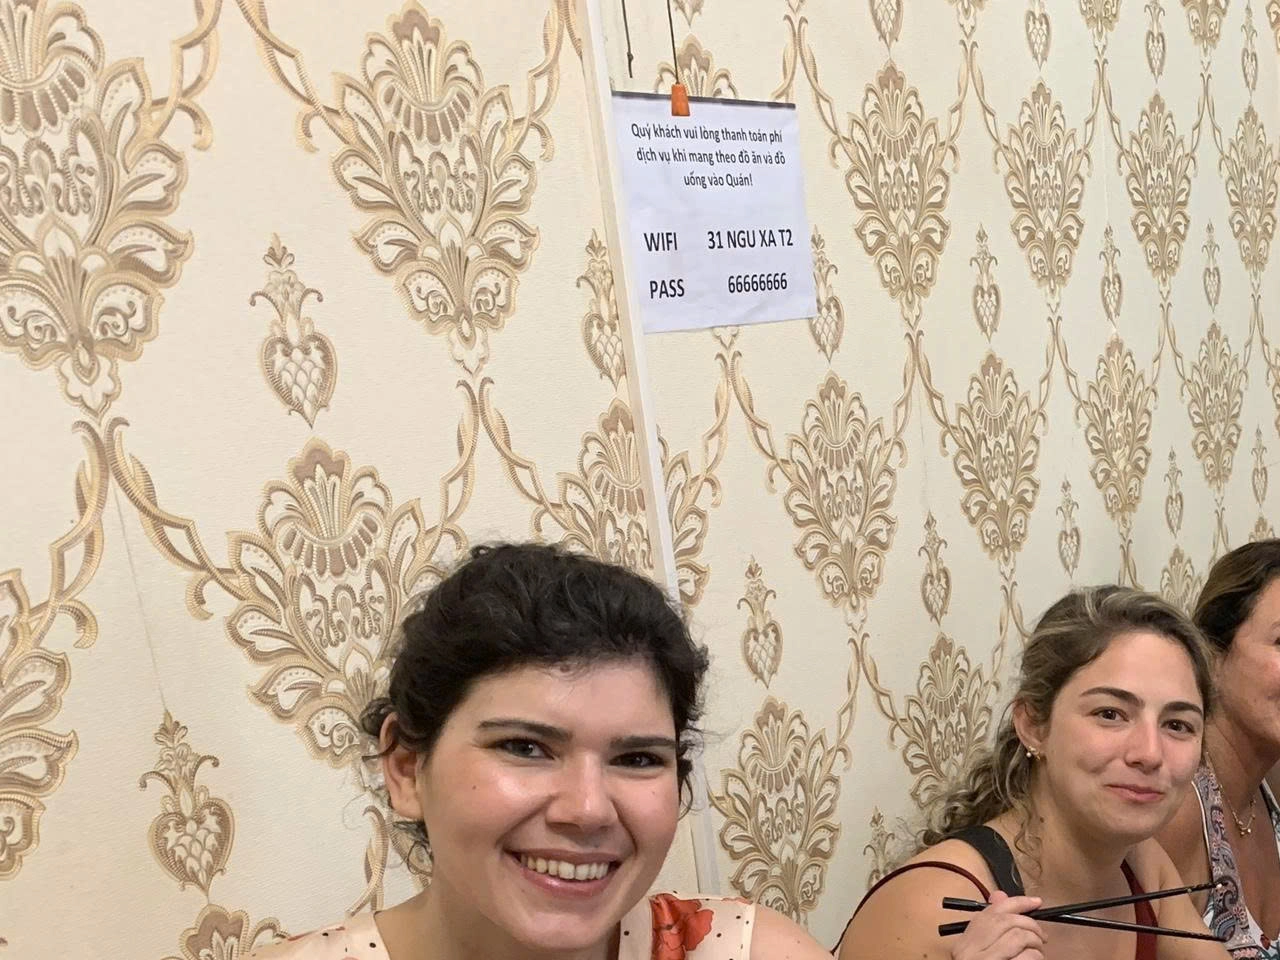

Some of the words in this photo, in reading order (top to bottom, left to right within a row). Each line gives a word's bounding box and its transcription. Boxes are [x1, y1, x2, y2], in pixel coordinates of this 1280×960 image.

[631, 123, 651, 140] Quý
[653, 124, 682, 139] khách
[683, 126, 698, 140] vui
[700, 126, 721, 143] lòng
[722, 127, 748, 142] thanh
[749, 128, 768, 143] toán
[769, 129, 783, 145] phí
[636, 147, 657, 165] dịch
[658, 151, 671, 165] vụ
[672, 148, 687, 162] khi
[689, 151, 715, 166] mang
[716, 149, 737, 164] theo
[738, 149, 750, 164] đồ
[763, 151, 773, 165] và
[774, 149, 786, 165] đồ
[684, 170, 707, 189] uống
[707, 173, 724, 187] vào
[643, 232, 678, 252] WIFI
[707, 230, 724, 249] 31
[727, 229, 756, 249] NGU
[760, 229, 777, 247] XA
[778, 228, 794, 247] T2
[649, 278, 685, 299] PASS
[727, 272, 788, 294] 66666666
